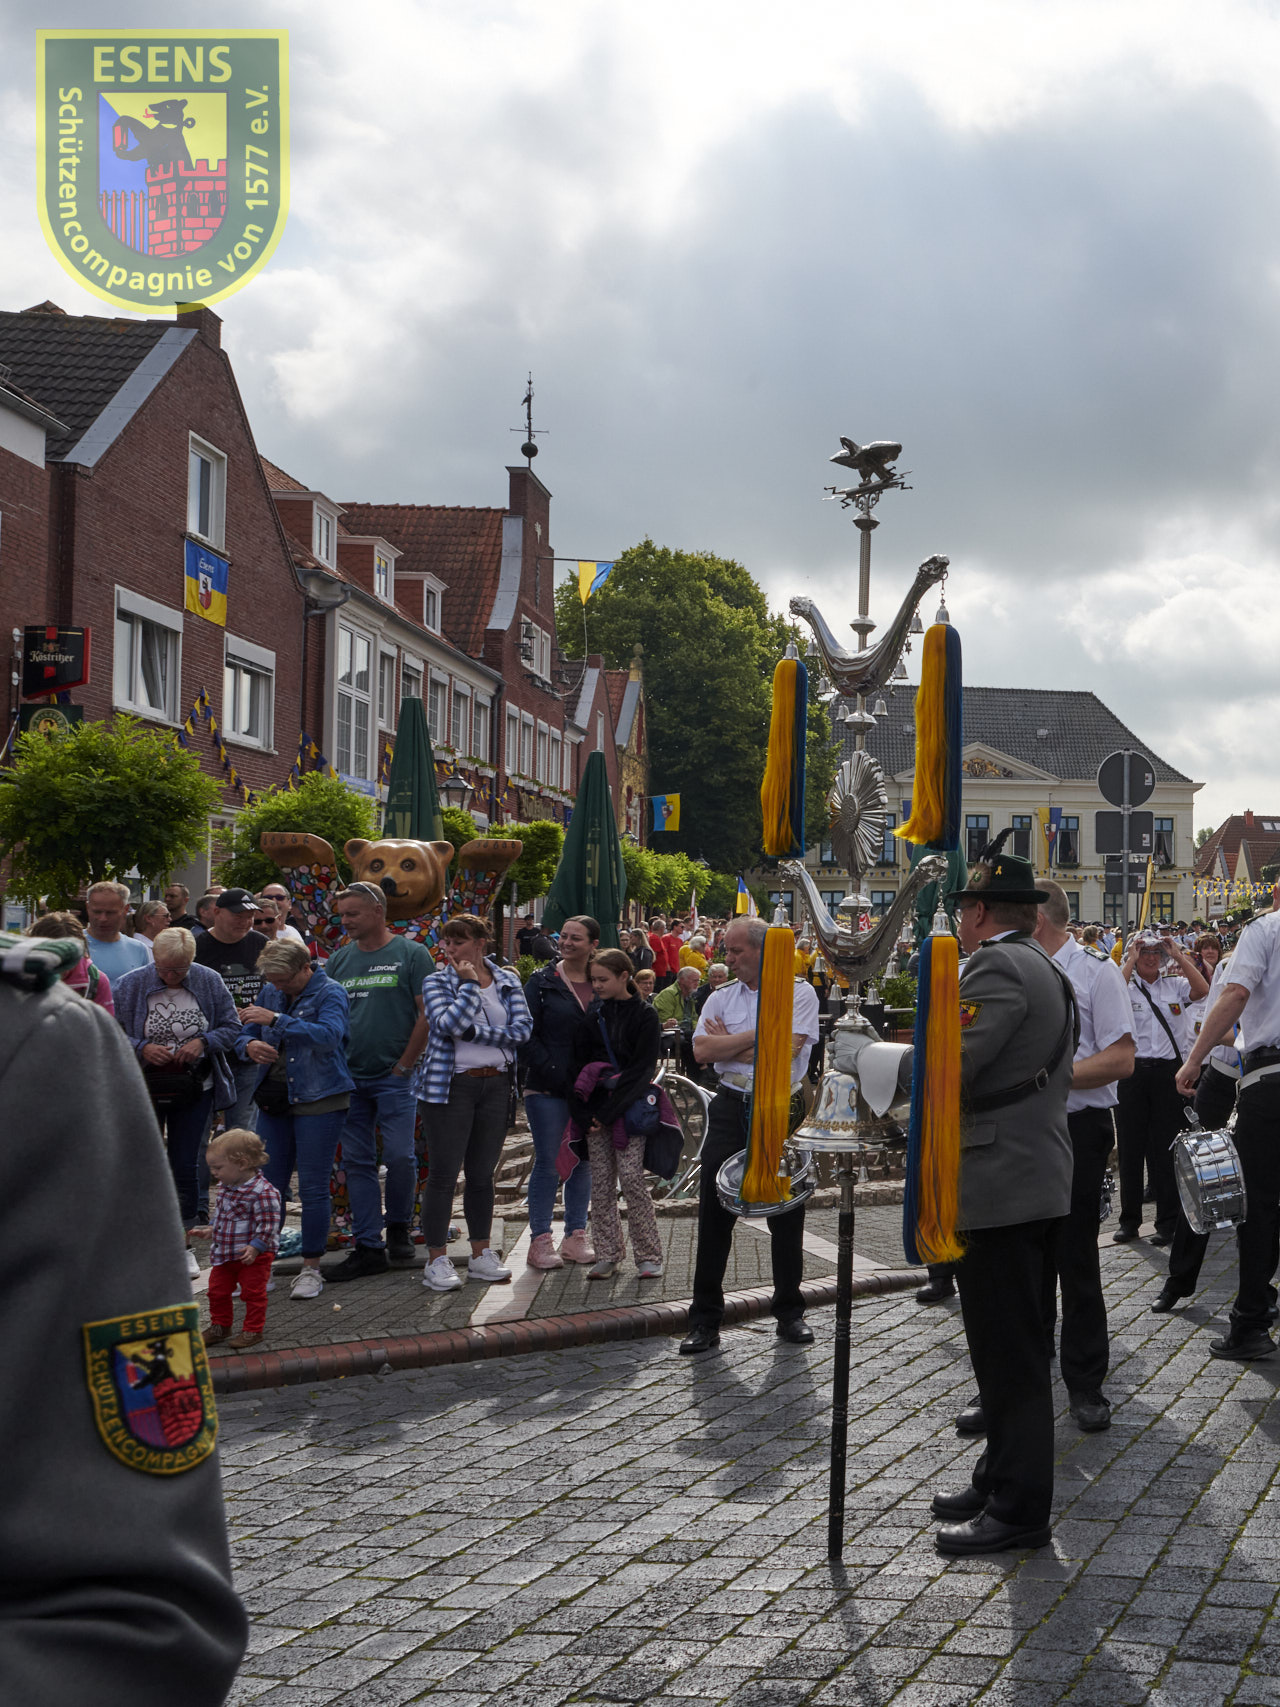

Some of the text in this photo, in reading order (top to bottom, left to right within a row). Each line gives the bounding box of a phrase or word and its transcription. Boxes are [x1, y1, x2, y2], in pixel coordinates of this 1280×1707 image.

[199, 558, 215, 573] Esens
[30, 651, 75, 664] Köstritzer
[342, 976, 393, 988] LOS ANGELES
[120, 1312, 185, 1337] ESENS
